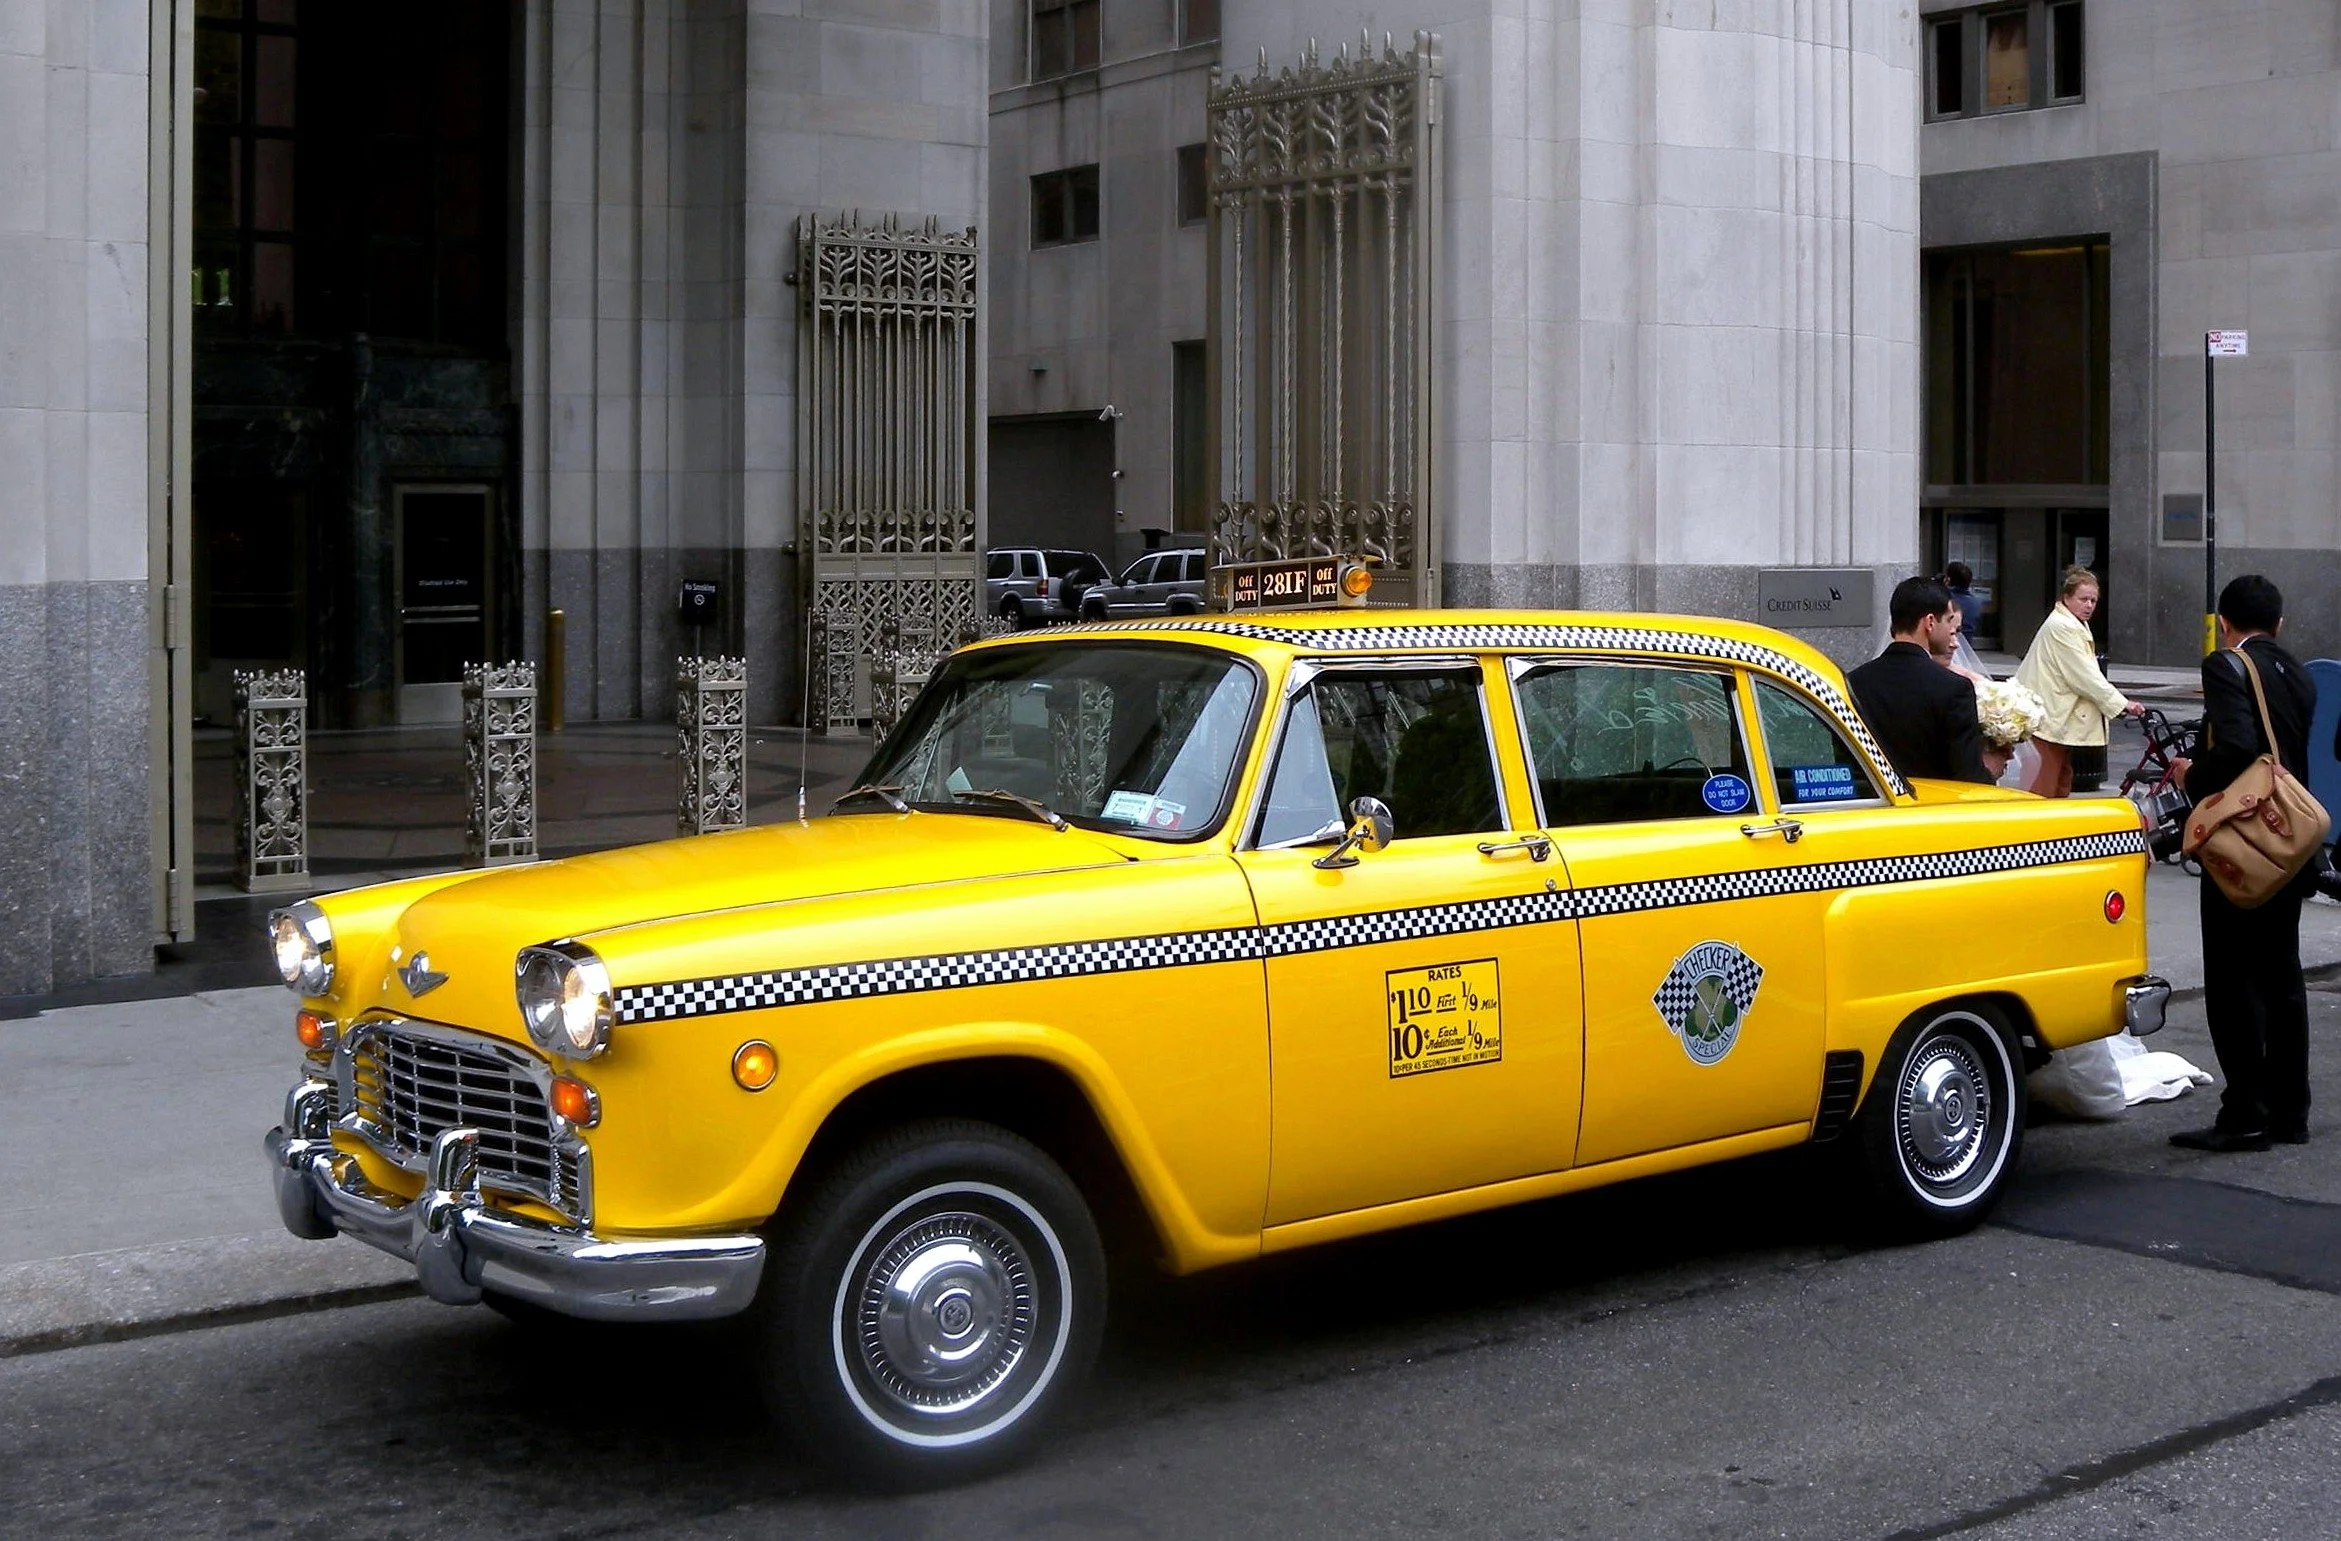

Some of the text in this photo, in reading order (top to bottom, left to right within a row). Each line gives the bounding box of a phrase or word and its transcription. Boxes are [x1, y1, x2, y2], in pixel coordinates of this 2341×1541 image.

[1316, 567, 1333, 581] Off
[692, 583, 716, 593] Smoking
[1238, 575, 1253, 588] Off
[1312, 583, 1337, 595] DUTY
[1235, 590, 1258, 602] DUTY
[1794, 767, 1852, 784] AIR CONDITIONED
[1714, 779, 1734, 788] PLEASE
[1708, 791, 1717, 799] DO
[1730, 788, 1745, 797] SLAM
[1798, 785, 1854, 798] FOR YOUR COMFORT
[1720, 799, 1737, 807] DOOR
[1684, 947, 1731, 979] CHECKER
[1428, 966, 1462, 982] RATES
[1436, 993, 1457, 1008] First
[1480, 999, 1498, 1010] Mile
[1438, 1025, 1458, 1038] Each
[1425, 1036, 1466, 1050] Additional
[1483, 1037, 1501, 1049] Mile
[1693, 1031, 1732, 1054] SPECIAL
